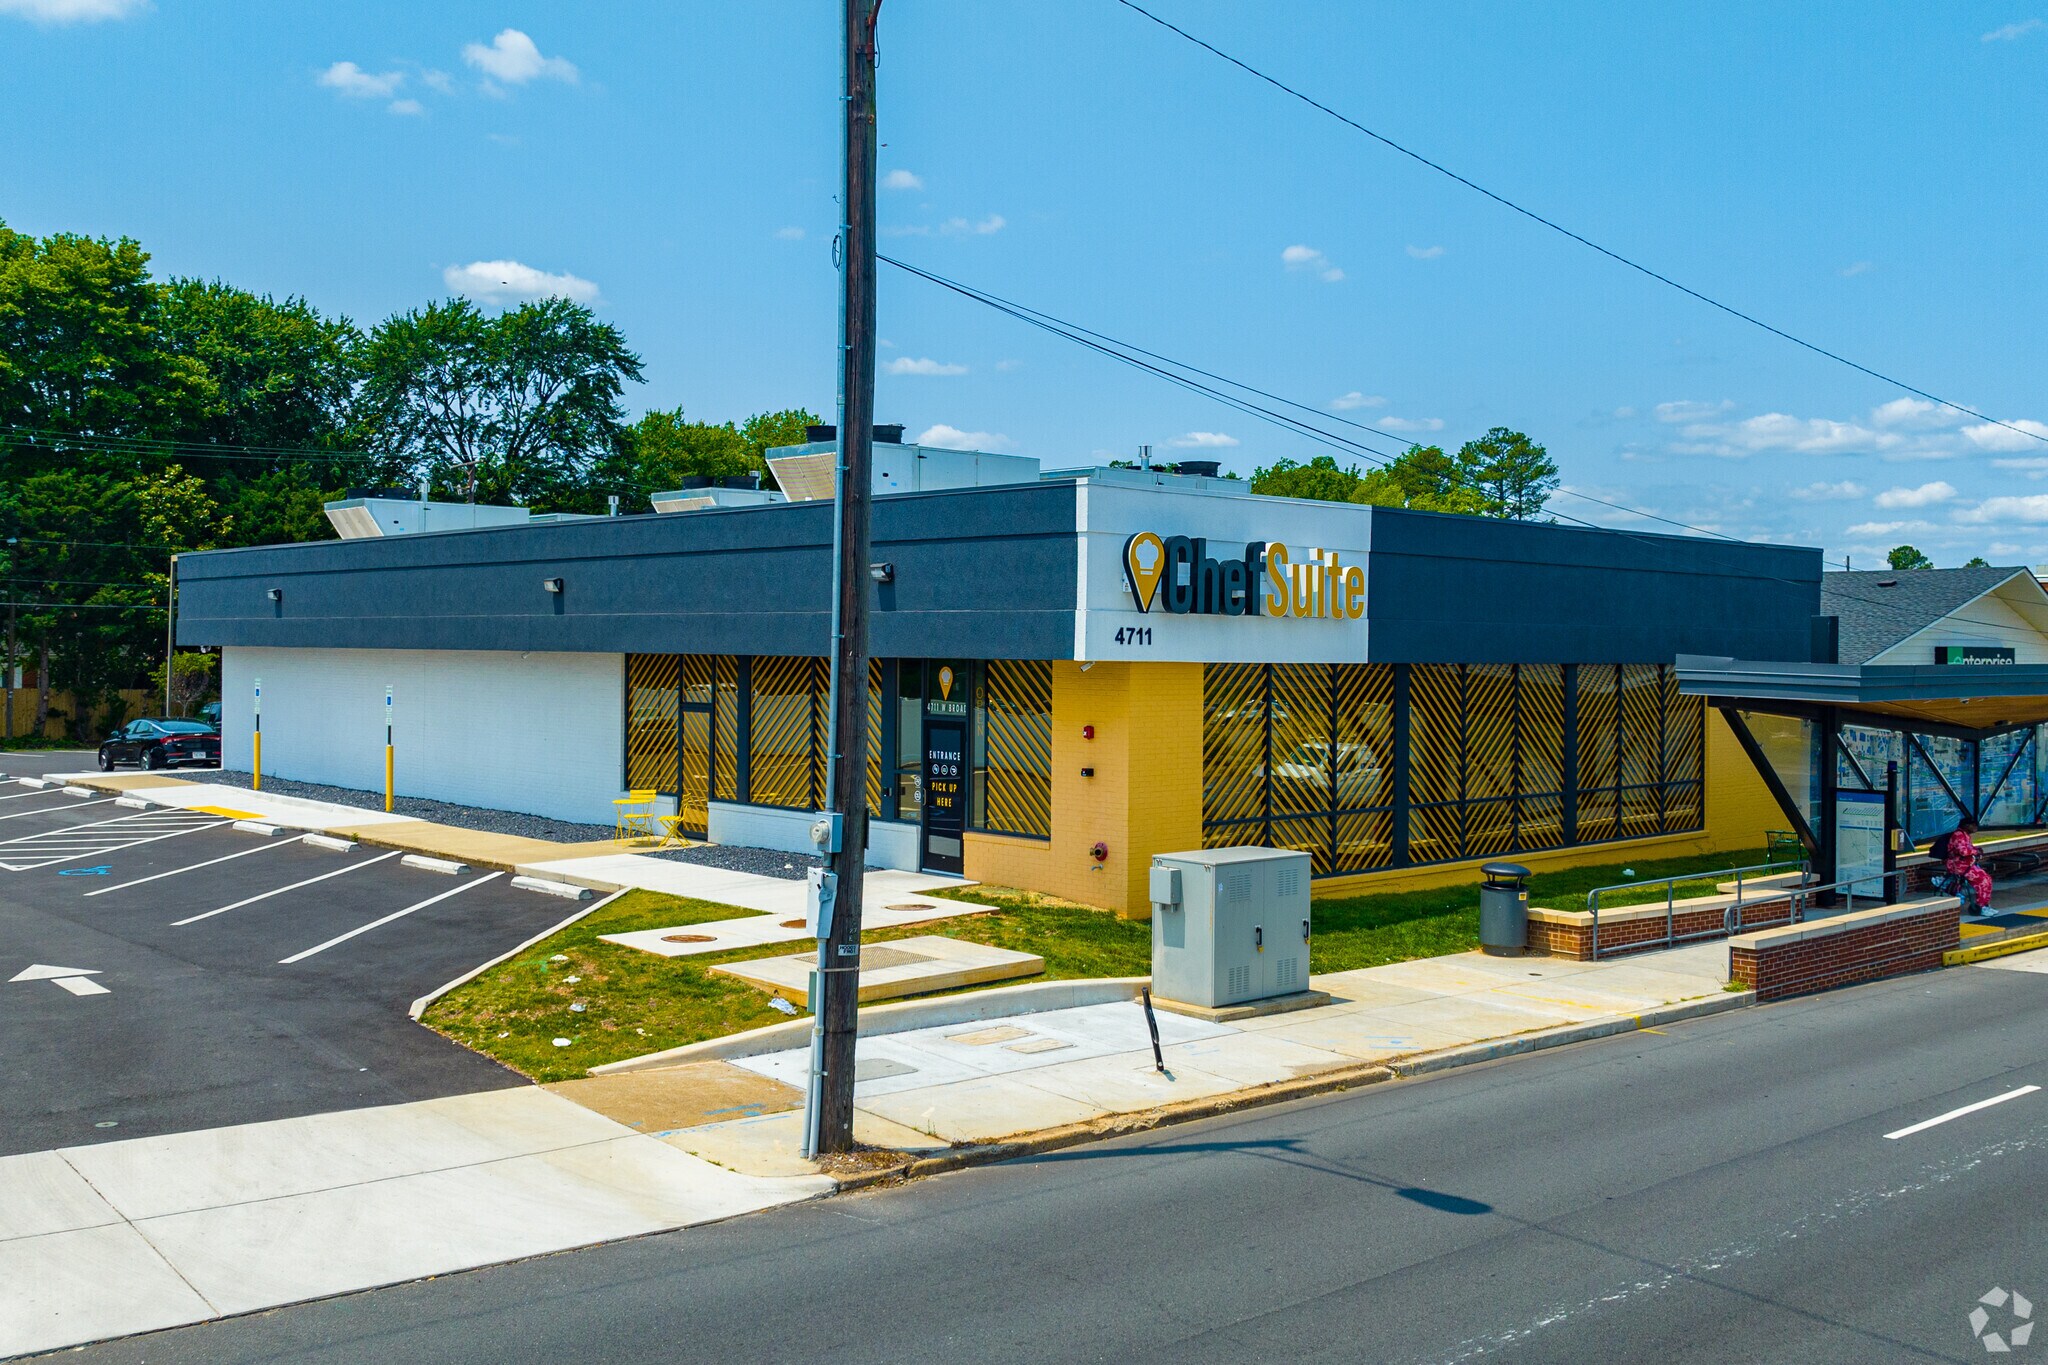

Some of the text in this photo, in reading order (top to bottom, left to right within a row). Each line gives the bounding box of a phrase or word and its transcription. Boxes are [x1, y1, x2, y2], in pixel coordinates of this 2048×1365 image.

[1161, 534, 1366, 620] ChefSuite
[1114, 627, 1152, 646] 4711
[927, 702, 939, 712] 4711
[941, 703, 947, 712] W
[929, 750, 961, 761] ENTRANCE
[931, 781, 958, 793] PICK UP
[936, 797, 952, 808] HERE
